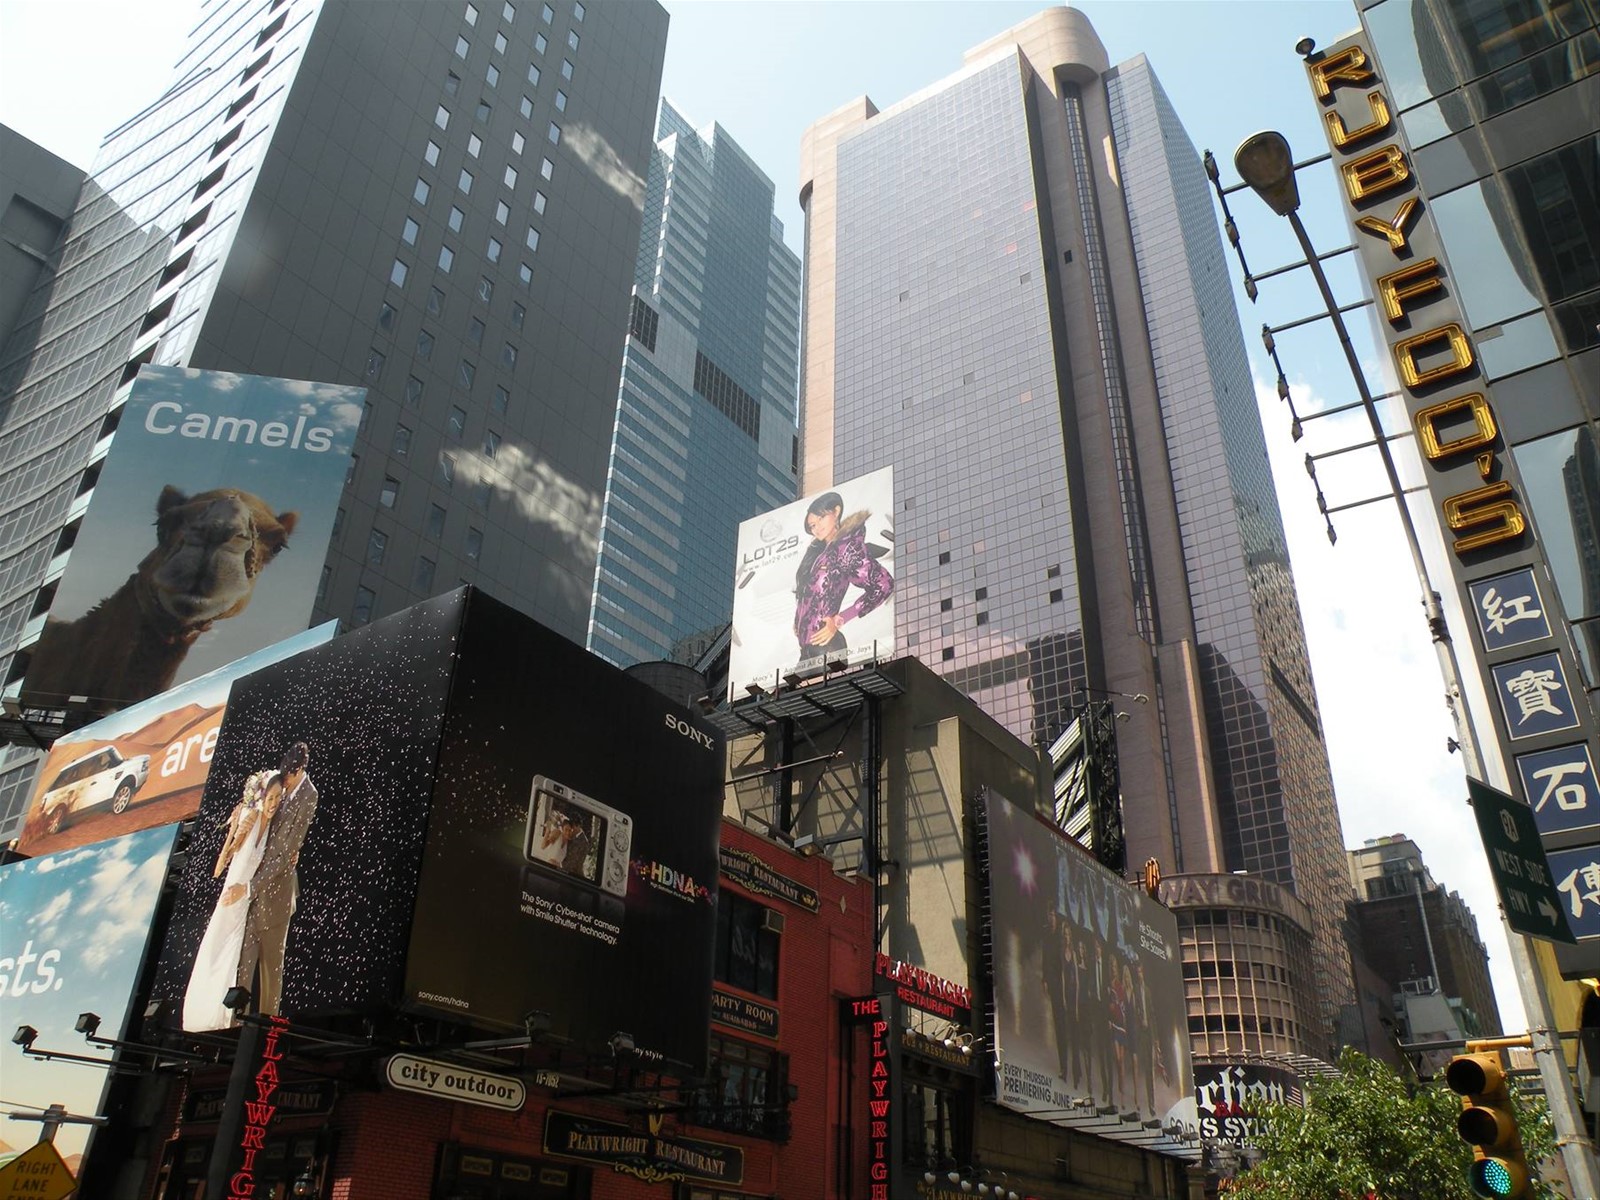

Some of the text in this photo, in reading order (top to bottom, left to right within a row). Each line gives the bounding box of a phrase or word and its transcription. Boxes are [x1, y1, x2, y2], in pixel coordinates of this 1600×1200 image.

[144, 401, 334, 453] Camels
[743, 535, 799, 565] LOT29
[665, 713, 715, 750] SONY
[161, 726, 220, 777] are
[651, 861, 696, 898] HDNA
[754, 866, 799, 900] RESTAURANT
[1494, 848, 1549, 888] WEST SIDE
[520, 903, 535, 915] with
[535, 908, 555, 924] Smile
[554, 913, 578, 931] Shutter
[521, 890, 621, 934] The Sony Cyber-shot camera
[1507, 886, 1532, 916] HWY
[876, 951, 973, 1011] PLAYWRIGHT
[418, 990, 470, 1009] sony.com/hdna
[712, 994, 774, 1026] ARTY ROOM
[852, 999, 880, 1016] THE
[897, 986, 956, 1018] RESTAURANT
[401, 1063, 516, 1100] city outdoor
[1004, 1063, 1053, 1087] EVERY THURSDAY
[227, 1015, 291, 1200] PLAYWRIG
[1004, 1077, 1051, 1103] PREMIERING
[1052, 1091, 1071, 1109] JUNE
[16, 1160, 57, 1175] RIGHT
[567, 1130, 726, 1176] PLAYWRIGHT RESTAURANT
[12, 1178, 49, 1192] LANE
